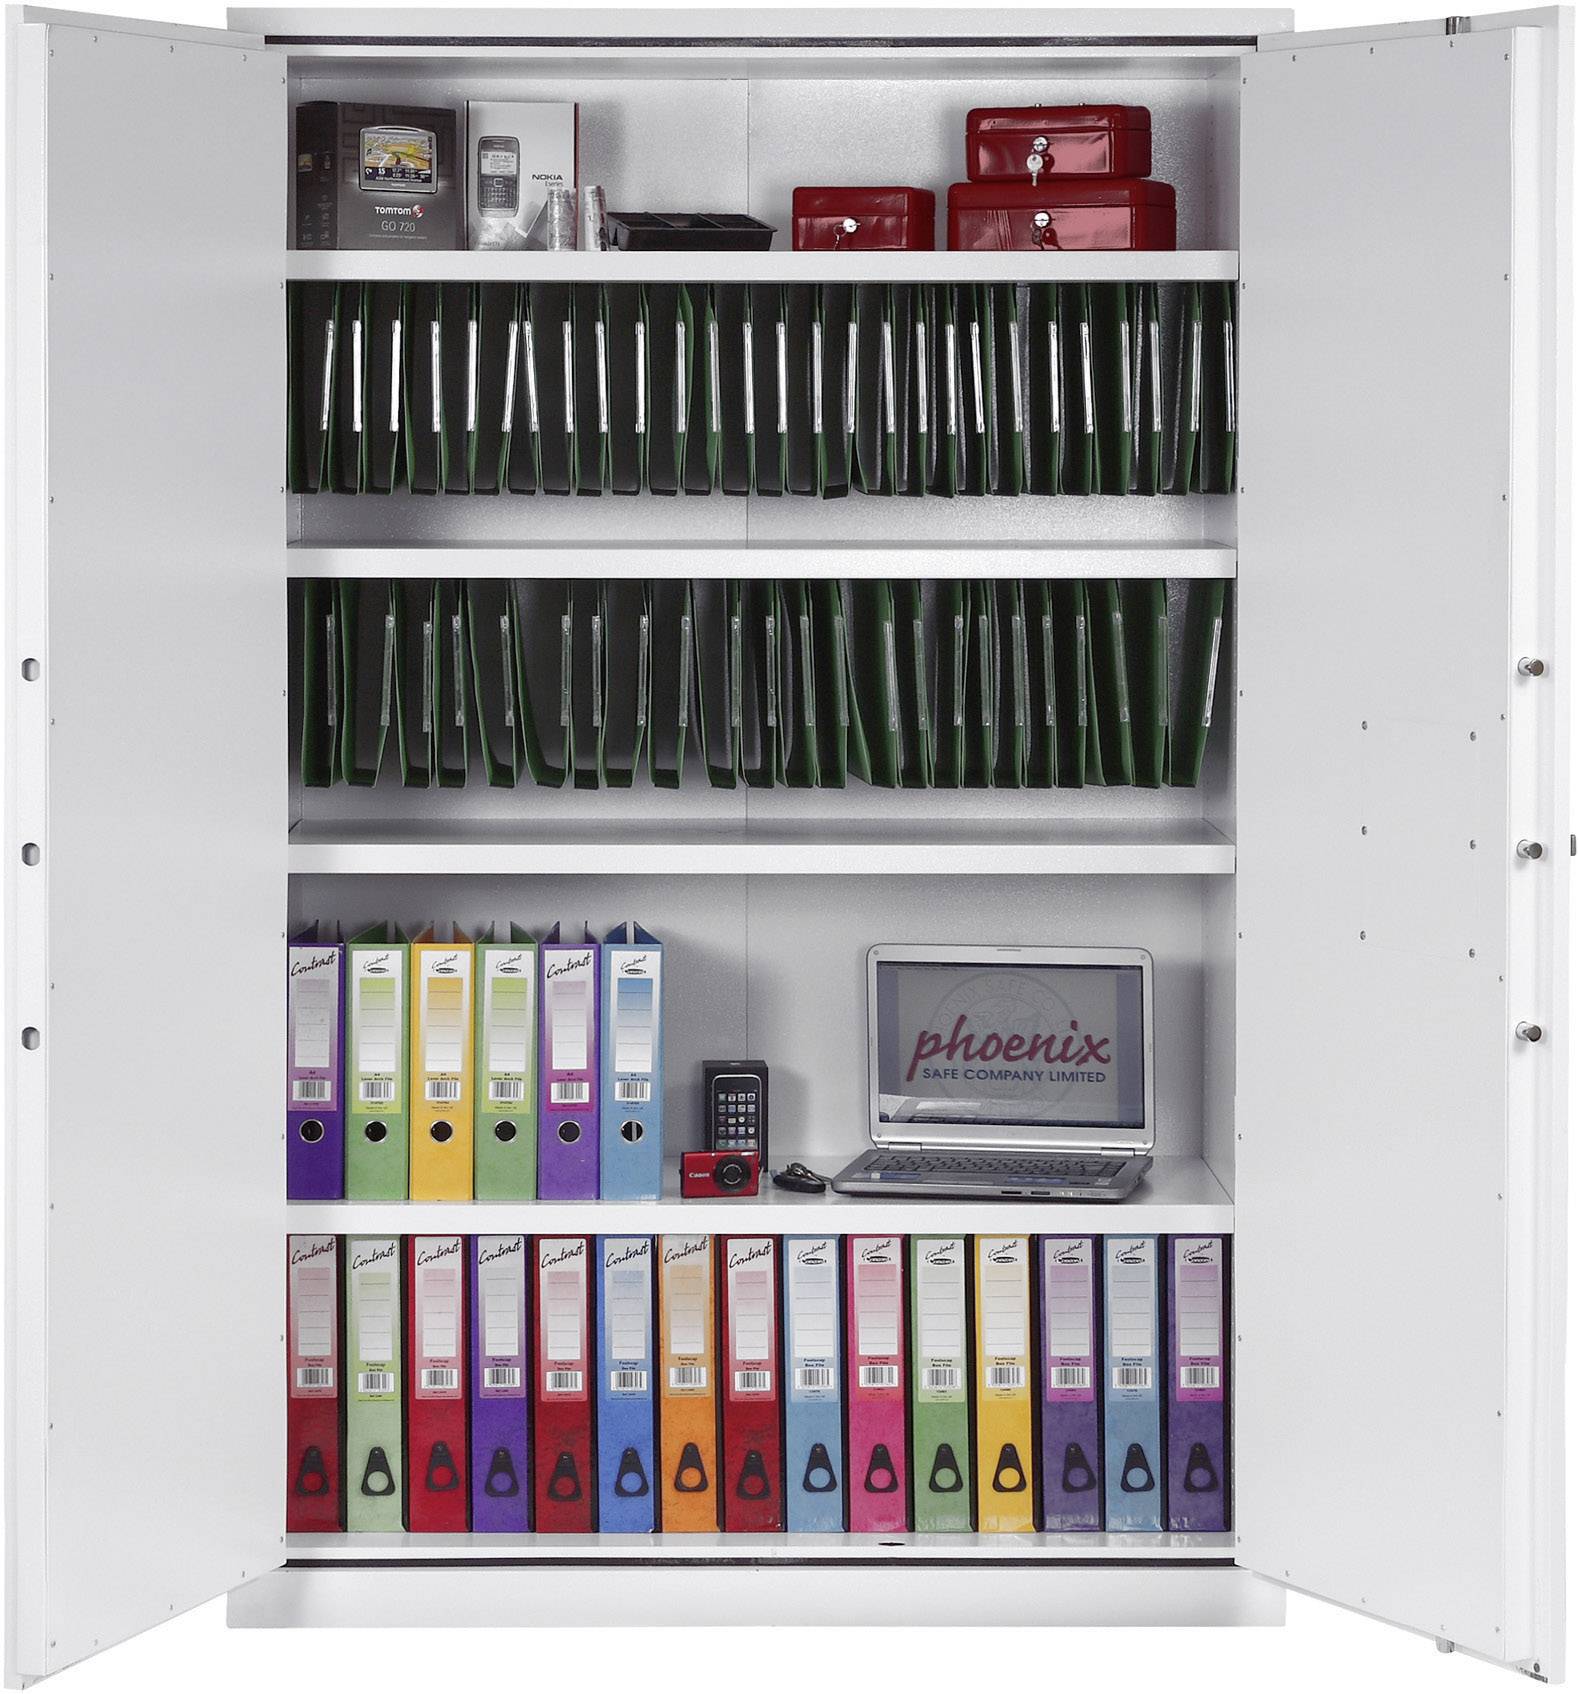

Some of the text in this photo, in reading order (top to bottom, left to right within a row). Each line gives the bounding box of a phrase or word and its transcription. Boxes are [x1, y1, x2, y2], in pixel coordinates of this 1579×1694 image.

[381, 220, 416, 233] GO 720
[291, 951, 336, 976] Contrast
[547, 953, 591, 979] Contrast
[906, 1014, 1111, 1082] phoenix
[922, 1068, 1106, 1083] SAFE COMPANY LIMITED
[688, 1171, 710, 1179] Canon
[292, 1238, 335, 1265] Contrast
[353, 1243, 395, 1270] Contrast
[417, 1239, 460, 1266] Contrast
[479, 1238, 522, 1265] Contrast
[541, 1241, 584, 1268] Contrast
[606, 1241, 649, 1268] Contrast
[664, 1236, 708, 1263] Contrast
[729, 1241, 772, 1269] Contrast
